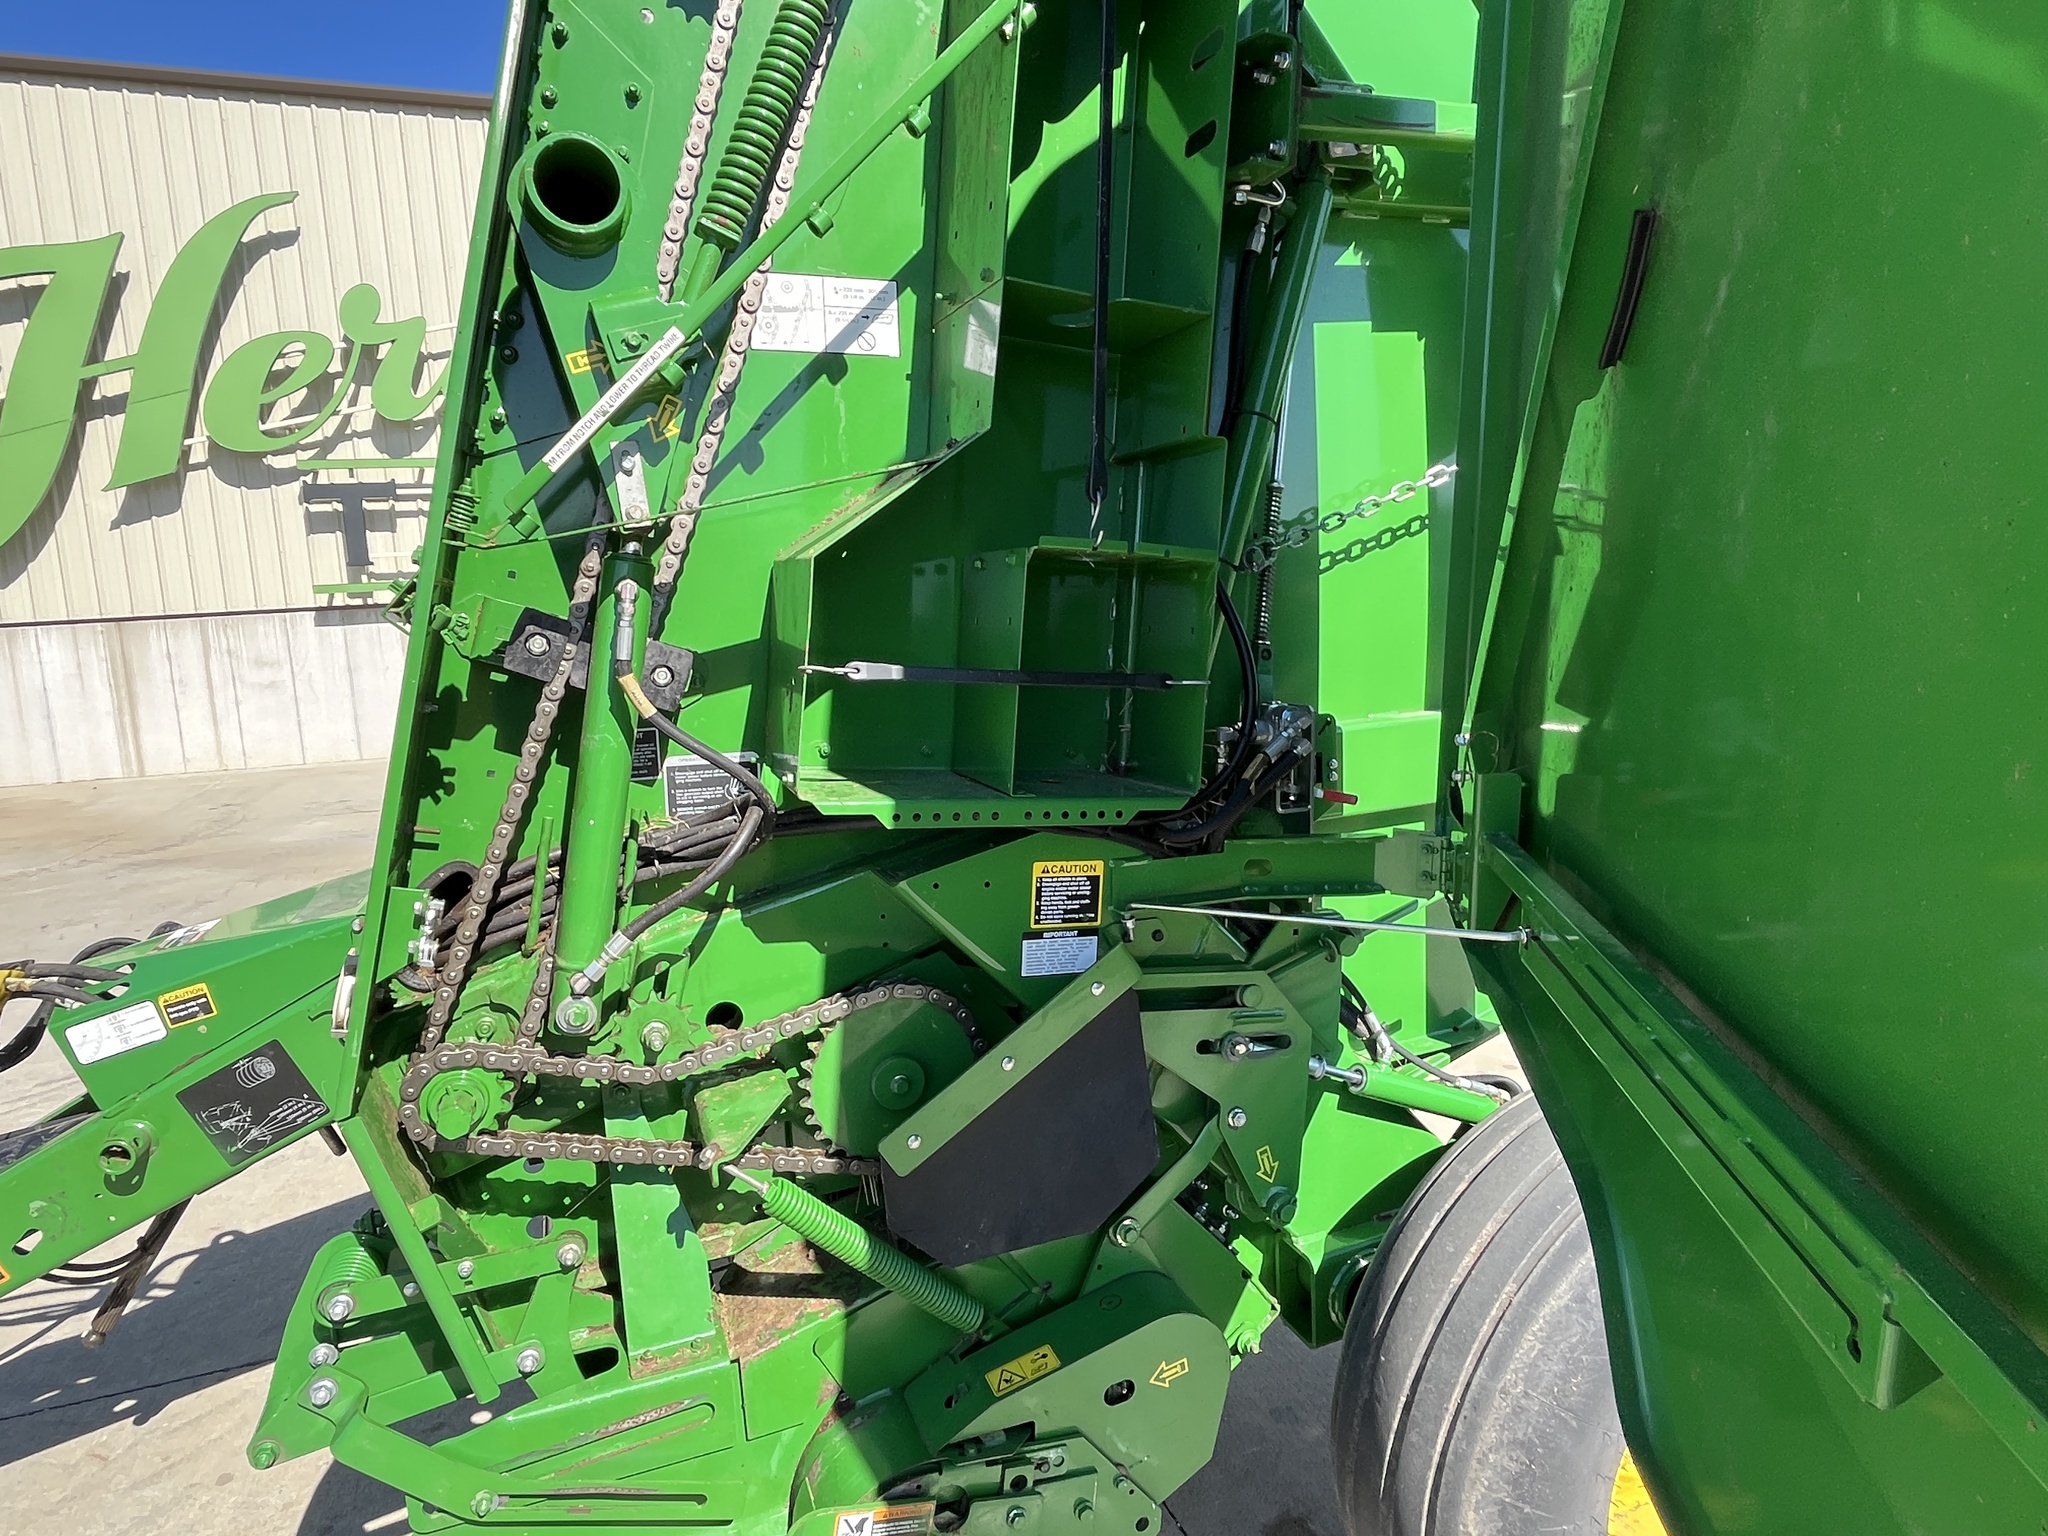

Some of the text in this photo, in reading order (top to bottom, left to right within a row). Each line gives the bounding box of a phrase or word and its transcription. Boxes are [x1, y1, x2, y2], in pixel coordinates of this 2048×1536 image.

[555, 438, 576, 459] FROM
[572, 417, 596, 441] NOTCH
[593, 405, 609, 420] AND
[605, 382, 630, 409] LOWER
[626, 374, 638, 385] TO
[635, 350, 661, 376] THREAD
[658, 333, 680, 353] TWINE
[1051, 864, 1097, 874] CAUTION
[168, 987, 204, 1001] CAUTION
[889, 1509, 922, 1517] WARNING
